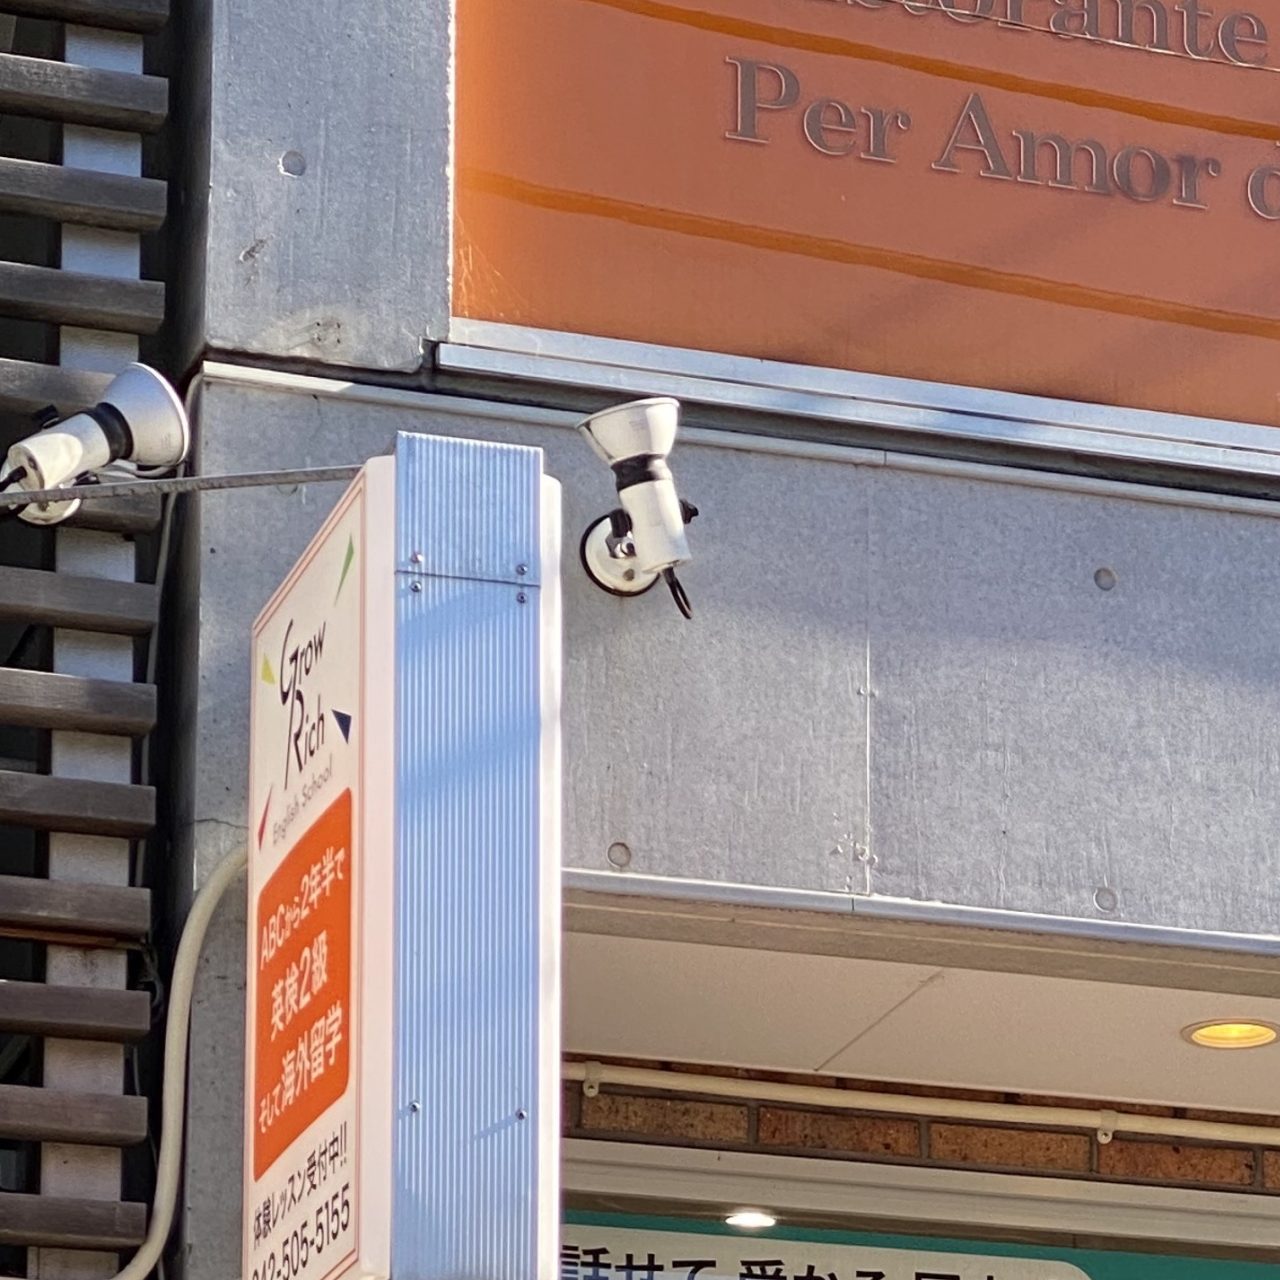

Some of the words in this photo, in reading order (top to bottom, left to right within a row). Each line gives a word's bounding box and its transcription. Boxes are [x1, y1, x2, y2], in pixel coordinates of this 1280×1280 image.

[725, 55, 911, 164] Per
[931, 92, 1221, 211] Amor
[280, 618, 326, 706] Grow
[285, 689, 325, 790] Rich
[259, 845, 345, 971] ABCから2年半で
[270, 930, 329, 1042] 英検2級
[258, 1000, 343, 1134] そして海外留学
